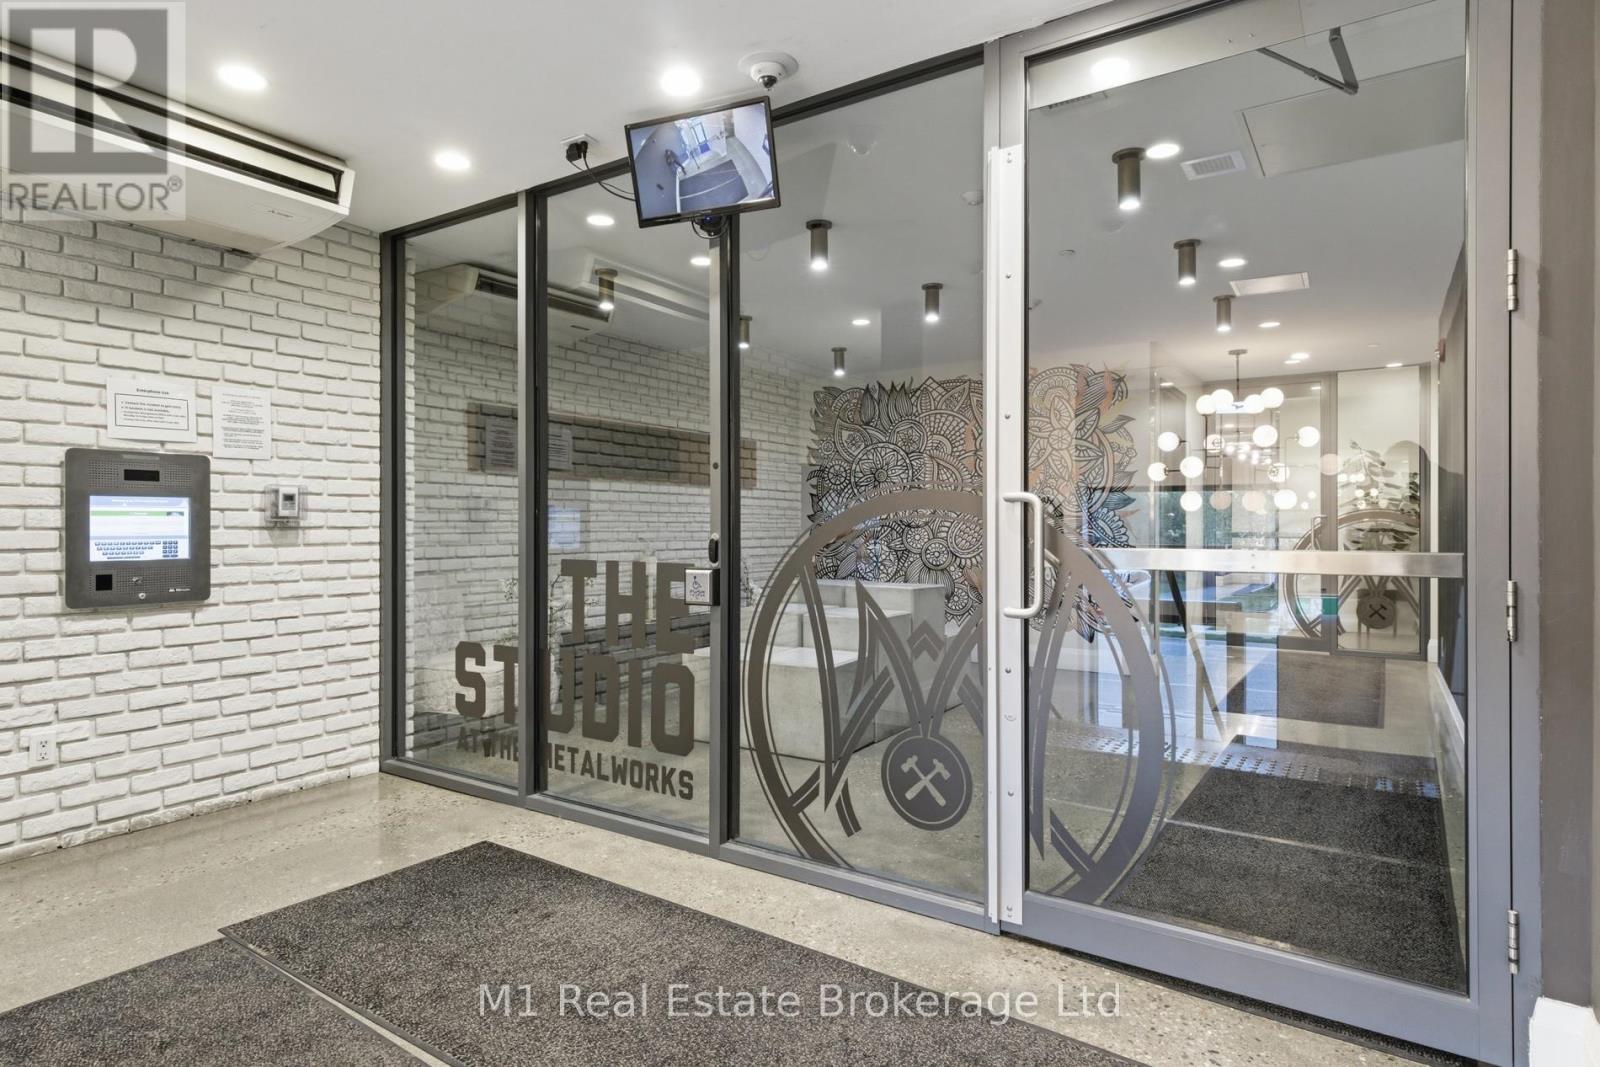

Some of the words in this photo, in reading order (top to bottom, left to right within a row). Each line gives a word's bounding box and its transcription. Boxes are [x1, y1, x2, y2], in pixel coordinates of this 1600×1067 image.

[561, 559, 695, 654] THE
[455, 641, 695, 757] STUDIO
[547, 743, 694, 801] ETALWORKS
